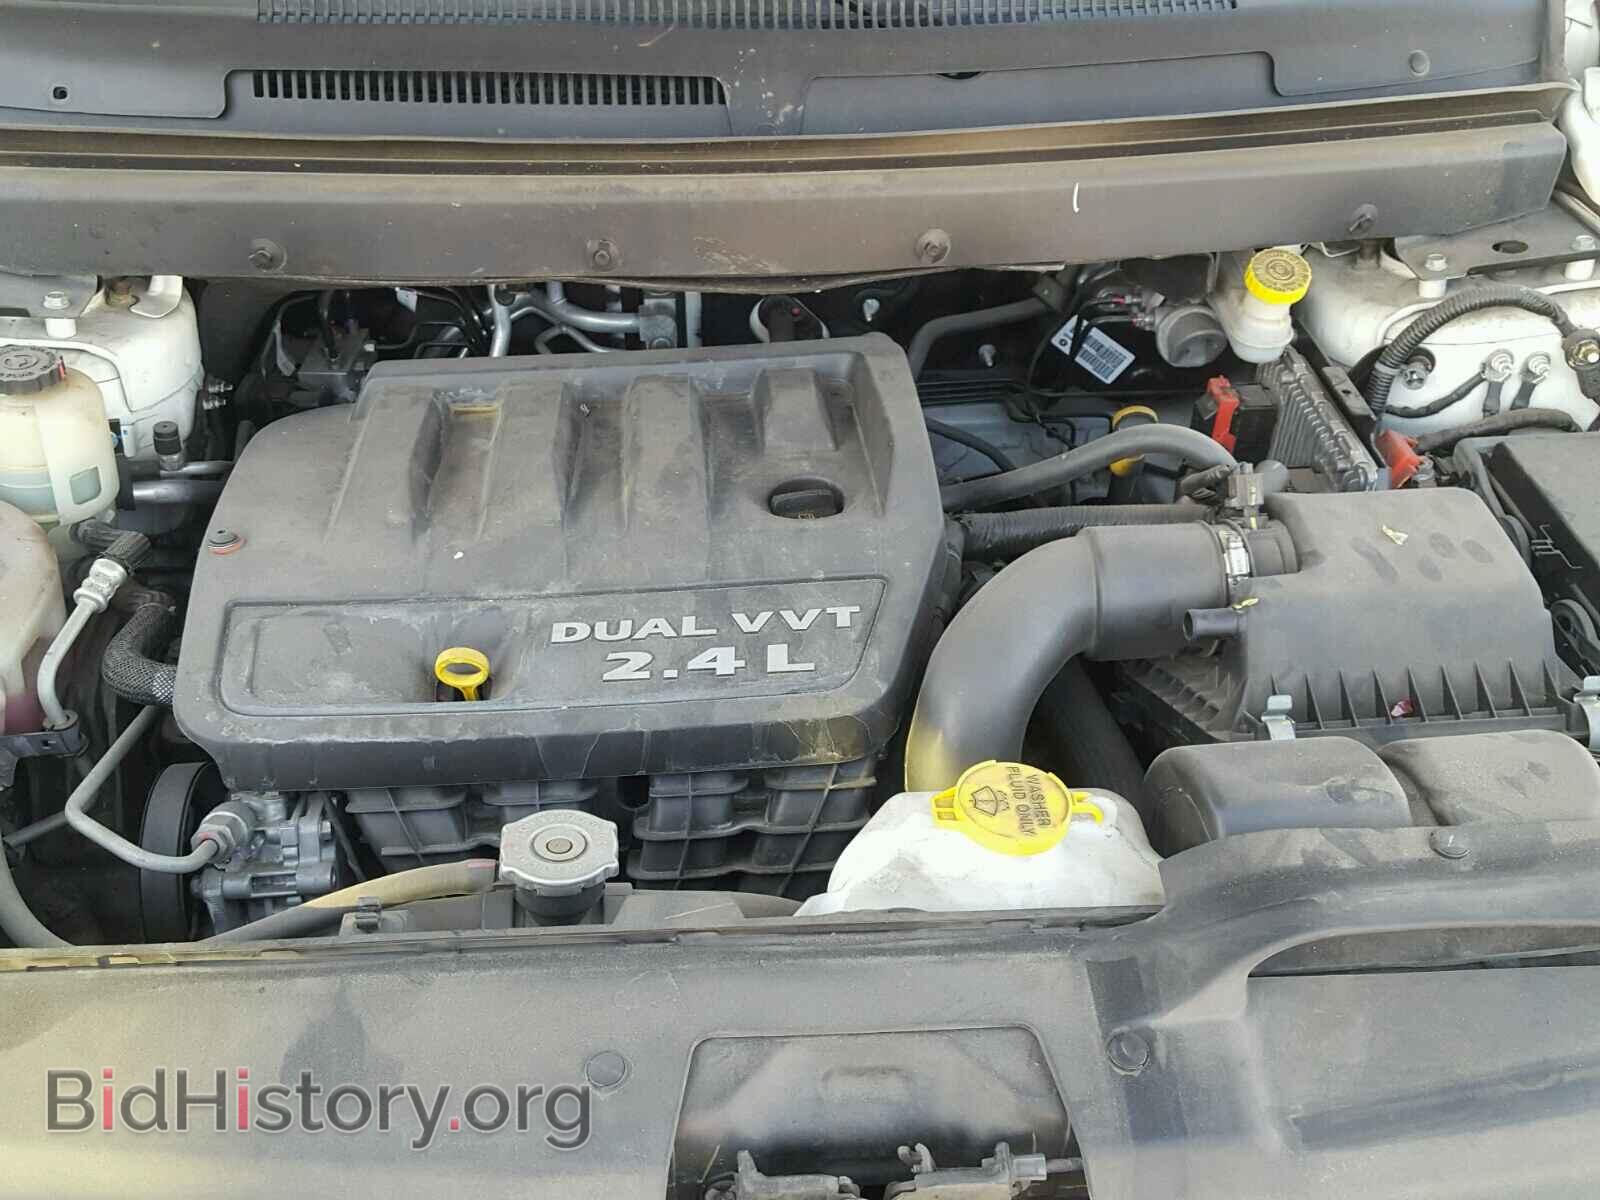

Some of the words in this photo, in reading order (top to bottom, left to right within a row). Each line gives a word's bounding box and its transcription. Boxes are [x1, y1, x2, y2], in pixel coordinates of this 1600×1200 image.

[551, 615, 718, 644] DUAL
[731, 605, 861, 634] VVT
[1006, 766, 1027, 800] FLUID
[1026, 774, 1051, 827] WASHER
[1015, 803, 1038, 836] ONLY
